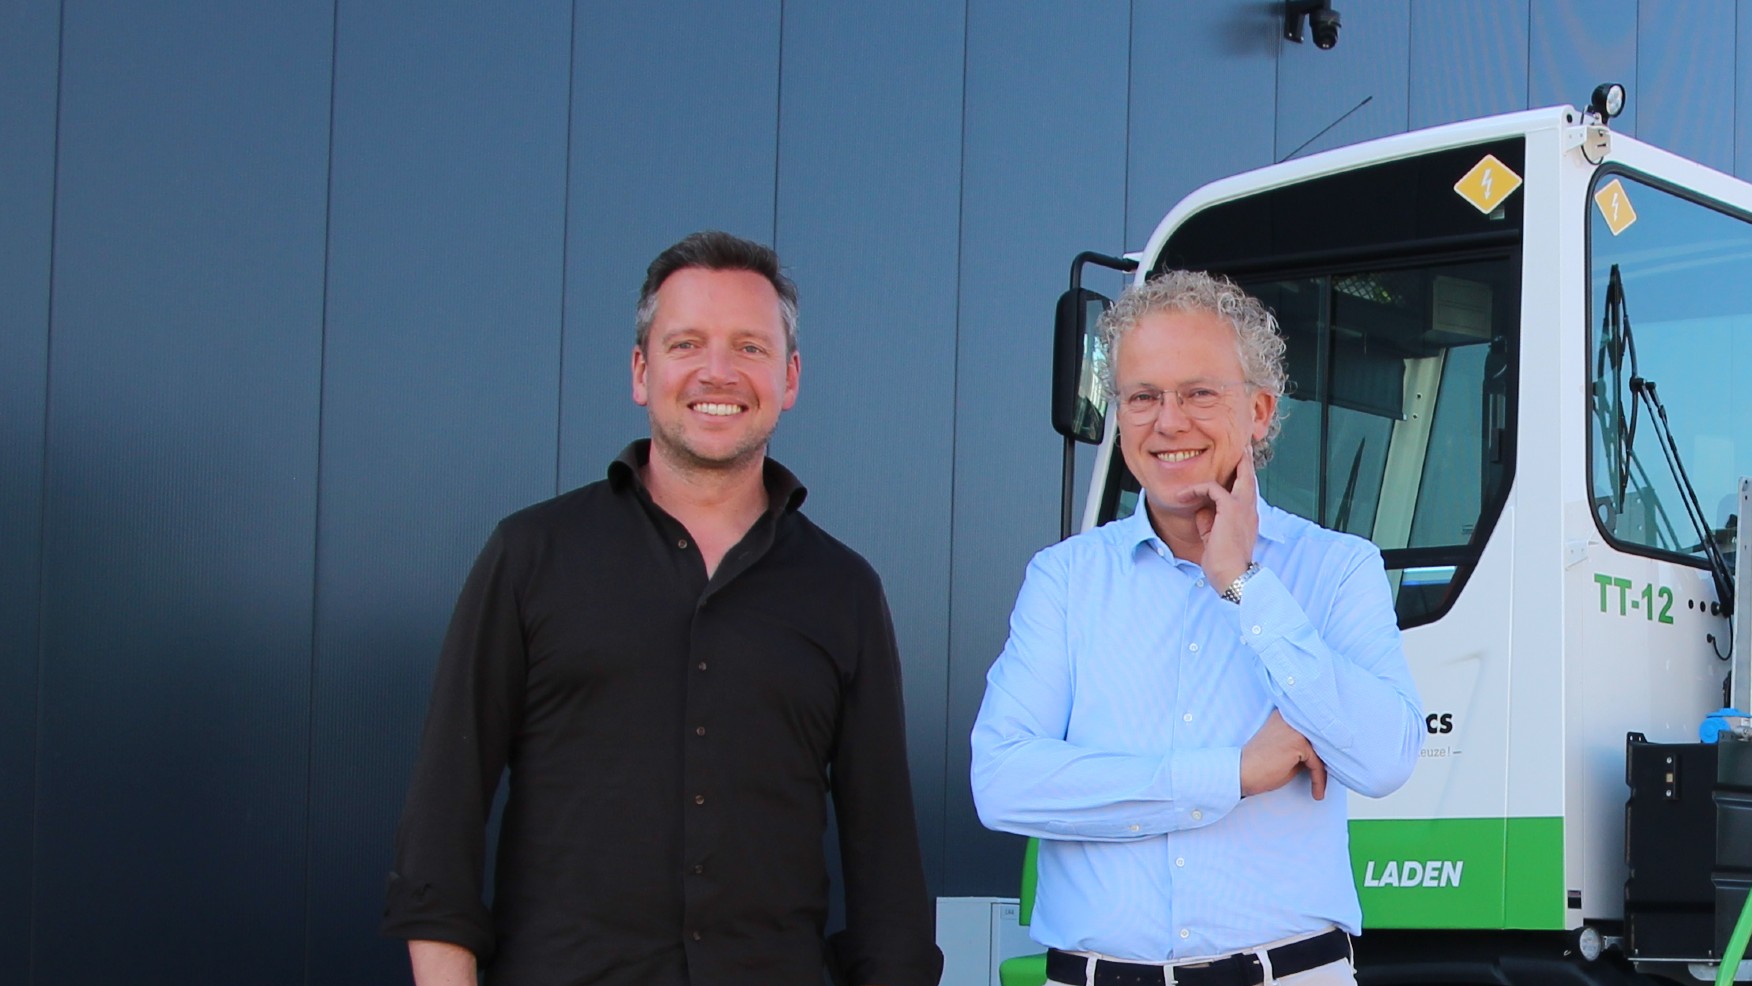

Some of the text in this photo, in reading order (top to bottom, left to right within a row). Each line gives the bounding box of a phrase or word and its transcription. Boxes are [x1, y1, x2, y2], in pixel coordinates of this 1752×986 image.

[1593, 573, 1675, 625] TT-12
[1418, 746, 1451, 758] euze!
[1363, 860, 1465, 888] LADEN
